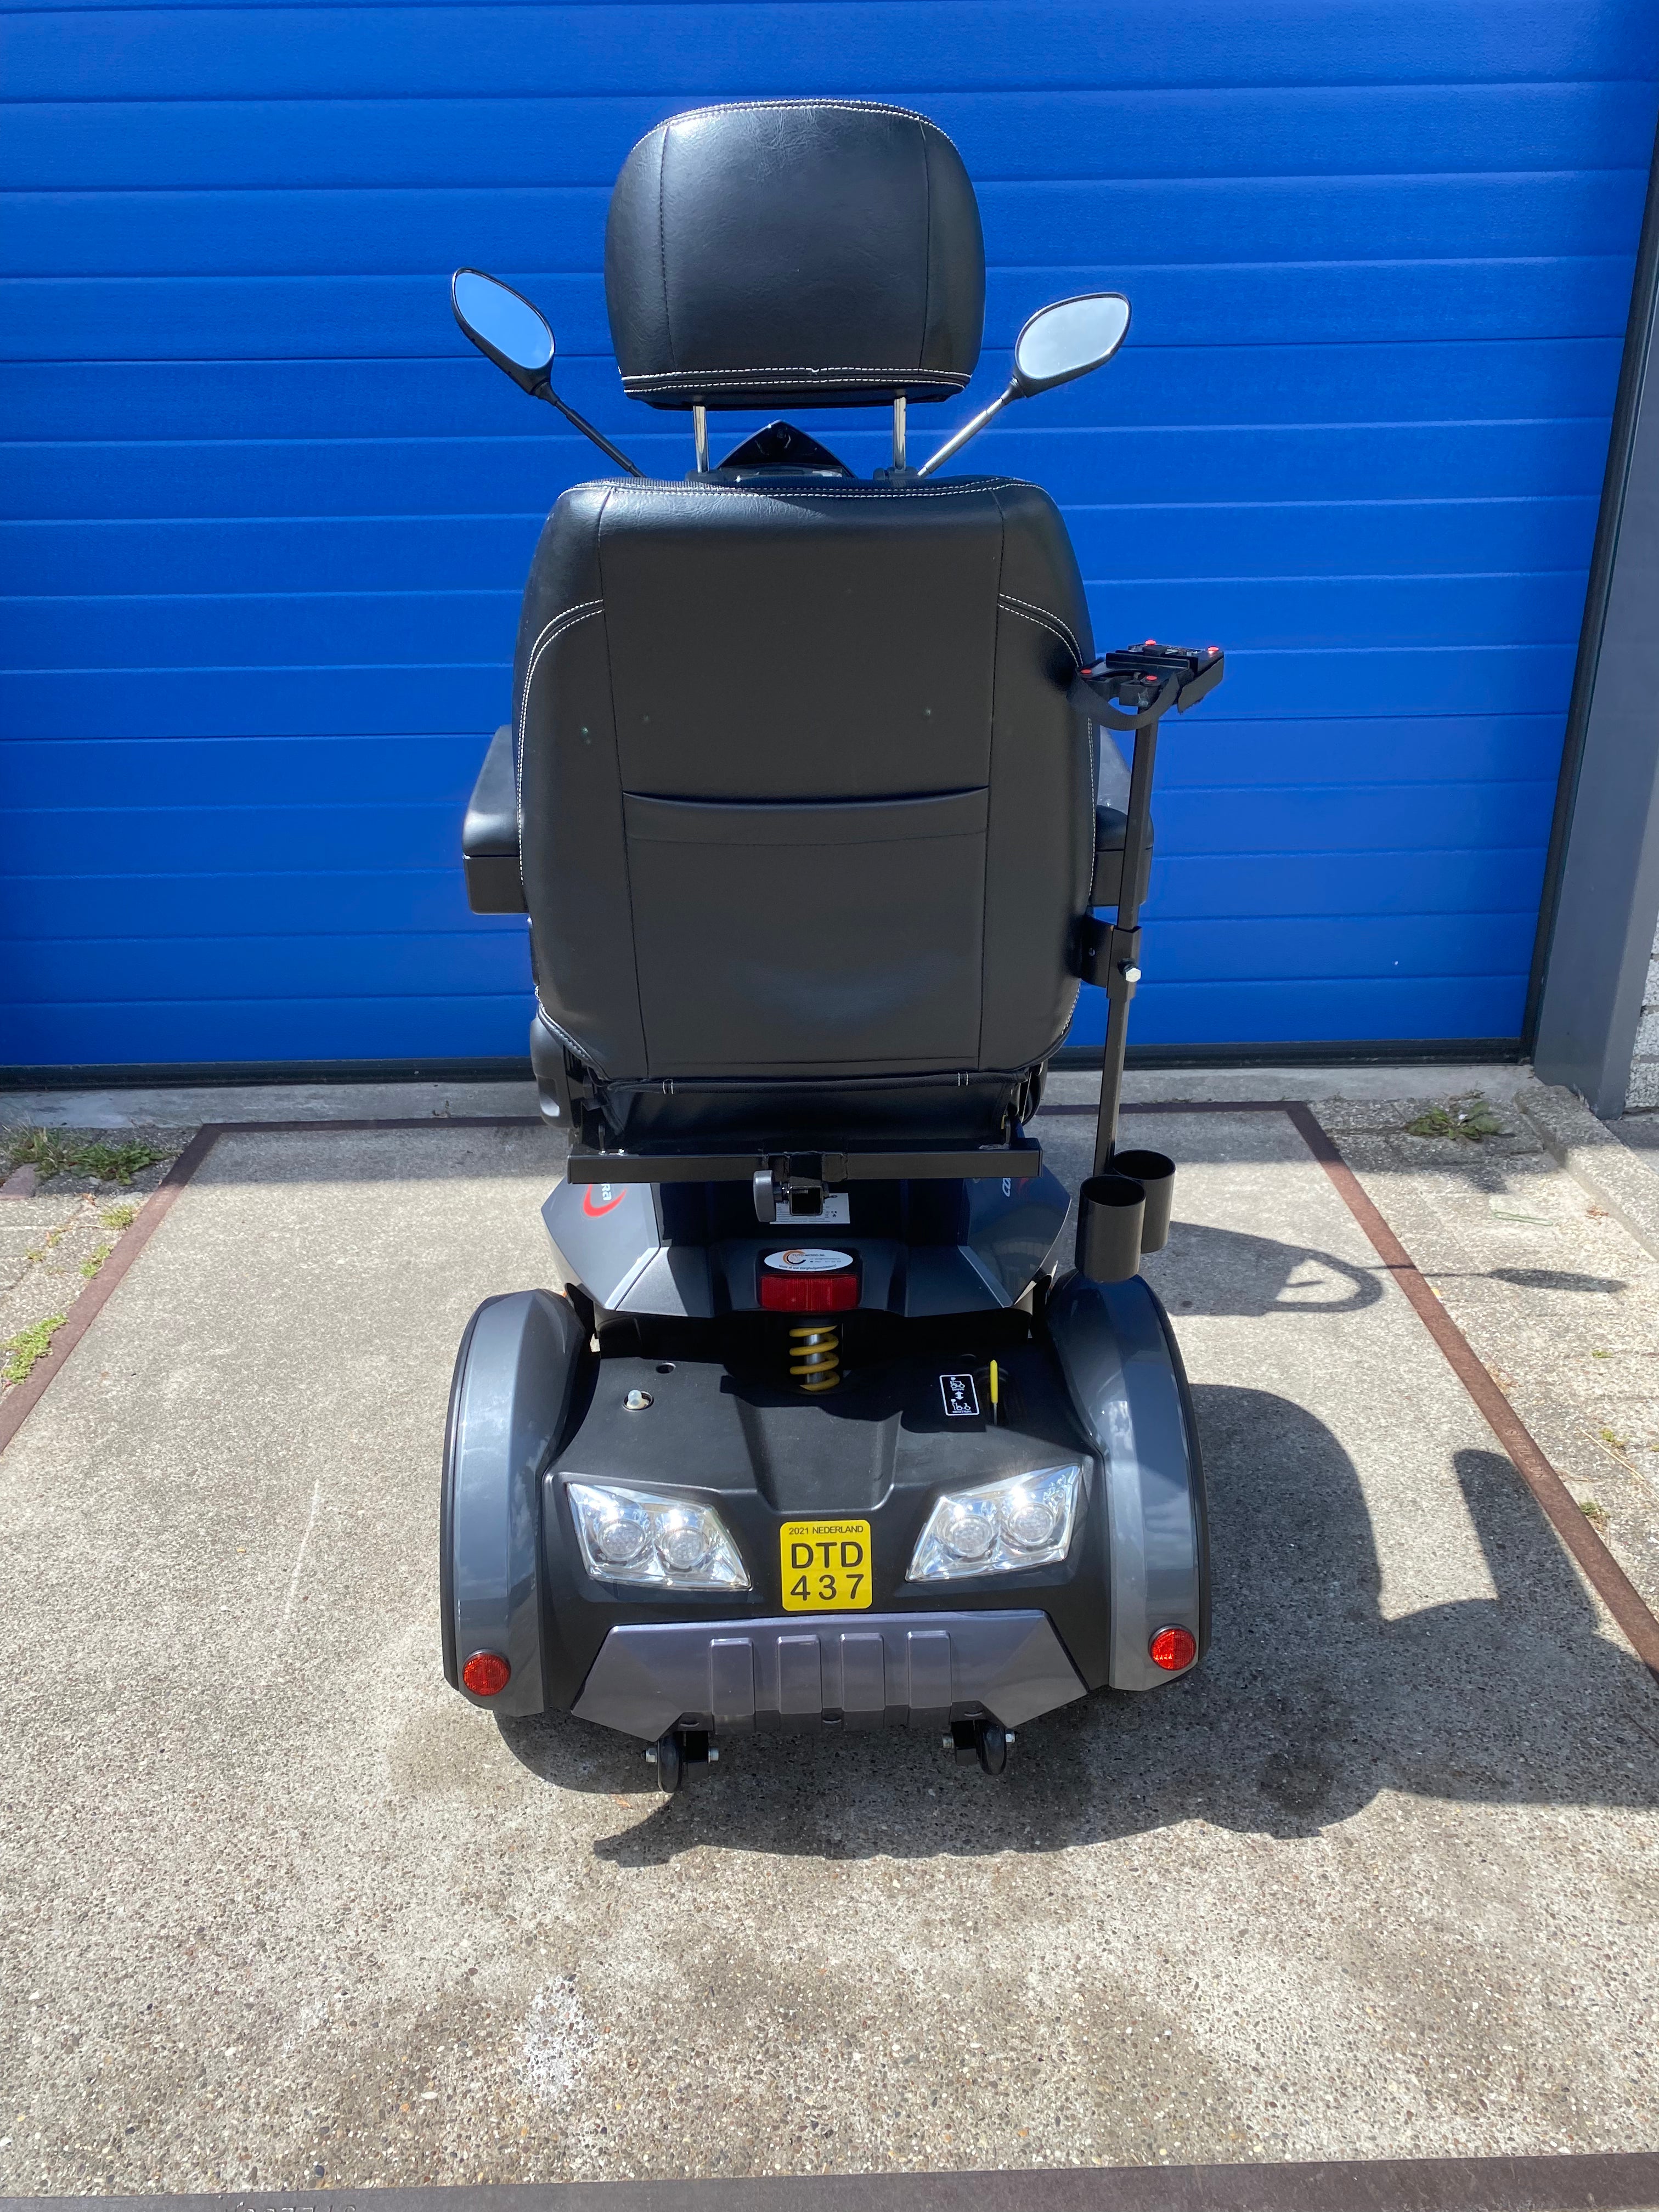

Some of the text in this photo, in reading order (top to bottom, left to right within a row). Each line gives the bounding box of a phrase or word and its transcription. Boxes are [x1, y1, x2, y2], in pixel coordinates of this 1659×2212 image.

[812, 1526, 863, 1534] NEDERLAND
[791, 1542, 863, 1568] DTD
[790, 1574, 864, 1601] 437
